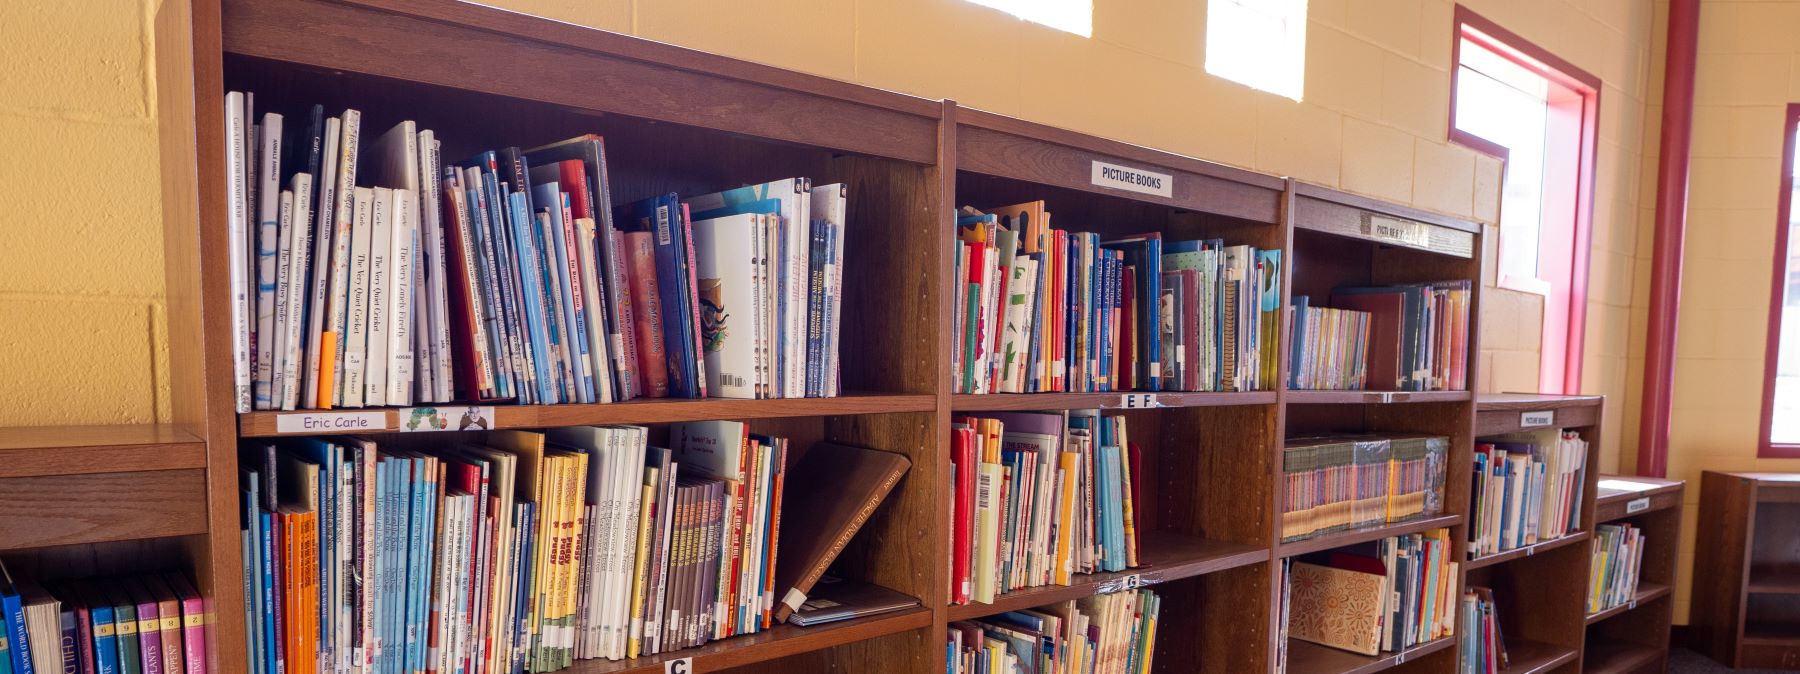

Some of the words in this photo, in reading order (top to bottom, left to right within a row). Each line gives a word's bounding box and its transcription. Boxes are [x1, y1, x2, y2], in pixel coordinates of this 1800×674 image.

[515, 160, 524, 176] TIM
[1102, 166, 1135, 185] PICTURE
[1136, 173, 1161, 189] BOOKS
[282, 248, 290, 262] The
[358, 254, 366, 267] The
[375, 256, 383, 268] The
[400, 247, 409, 262] The
[280, 264, 288, 279] Very
[355, 270, 364, 285] Very
[374, 271, 382, 285] Very
[399, 264, 408, 281] Very
[279, 282, 287, 299] Busy
[354, 287, 363, 306] Quiet
[373, 288, 382, 306] Quiet
[398, 284, 407, 307] Lonely
[278, 300, 286, 324] Spider
[373, 308, 382, 332] Cricket
[353, 309, 362, 334] Cricket
[1128, 395, 1135, 407] E
[1144, 395, 1151, 407] F
[304, 416, 331, 429] Eric
[335, 416, 368, 428] Carle
[1006, 441, 1016, 450] THE
[1016, 442, 1040, 451] STREAM
[855, 494, 880, 523] APACHE
[834, 523, 861, 553] INDIAN
[808, 553, 835, 584] BASKETS
[1128, 576, 1136, 588] G
[15, 611, 23, 625] THE
[17, 625, 26, 649] WORLD
[20, 650, 29, 667] BOOK
[671, 660, 686, 674] C
